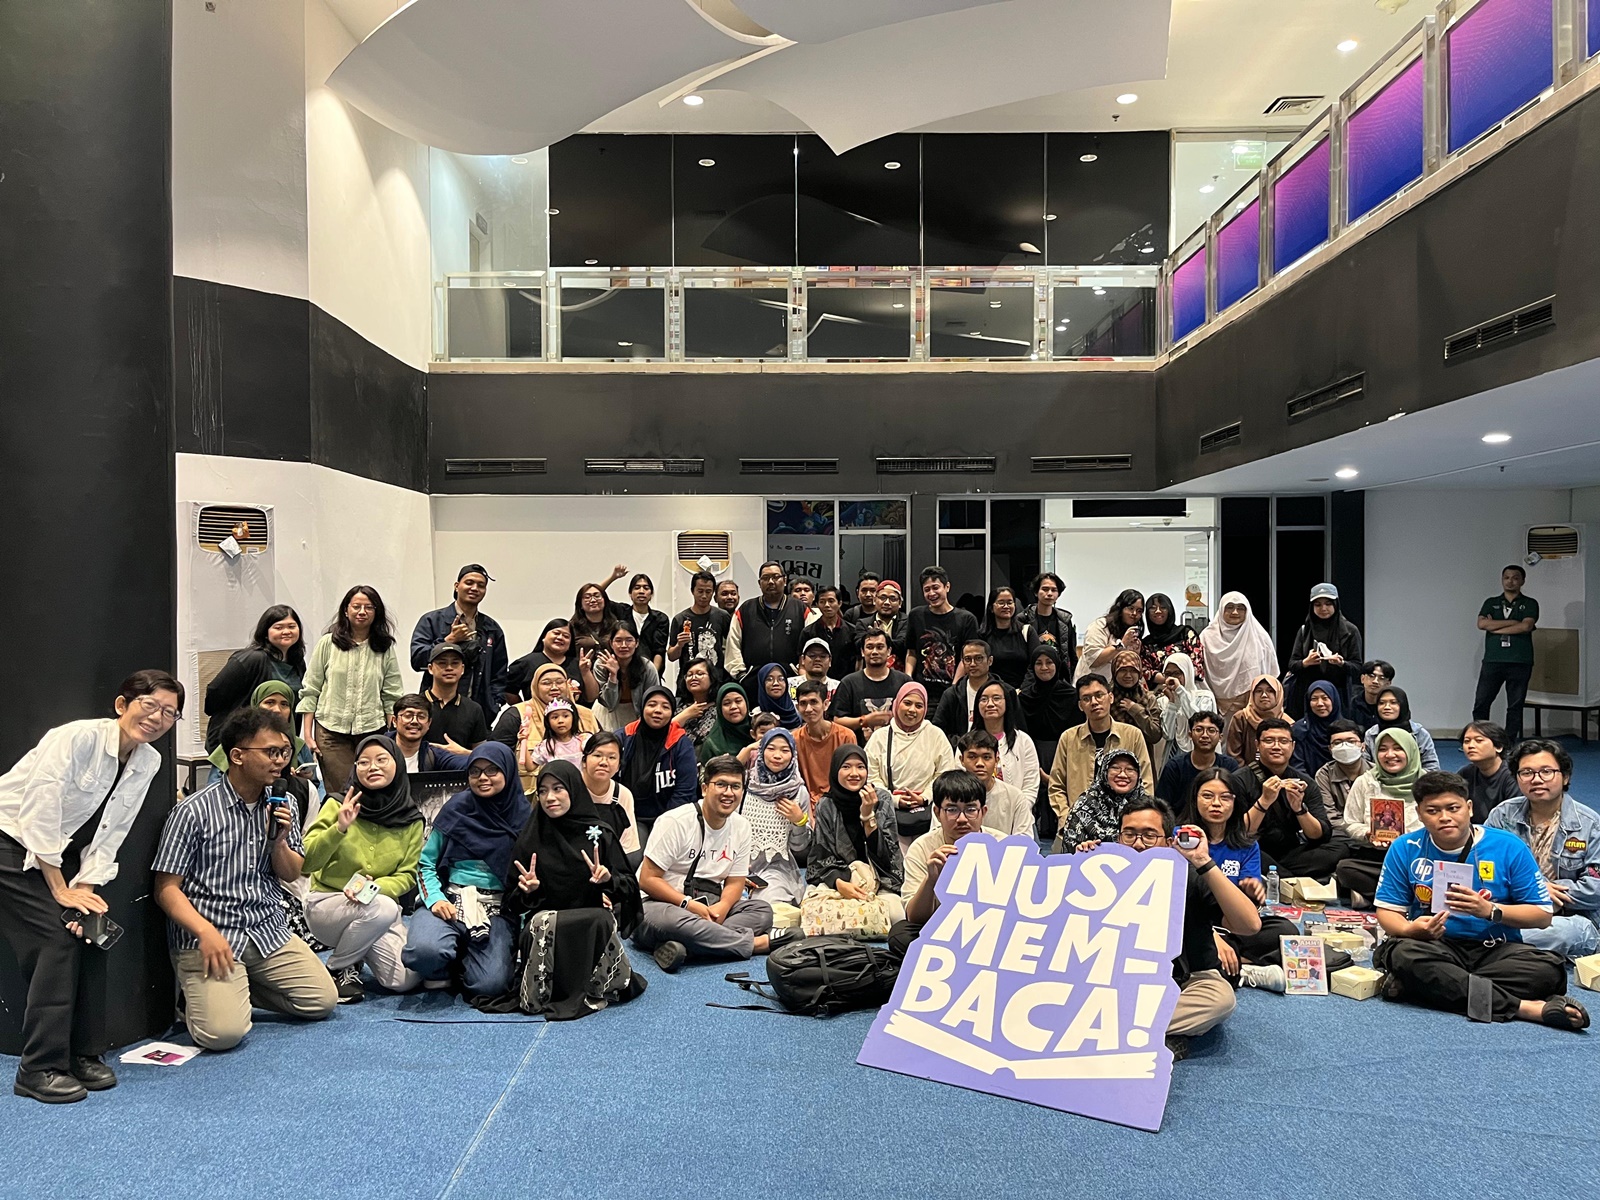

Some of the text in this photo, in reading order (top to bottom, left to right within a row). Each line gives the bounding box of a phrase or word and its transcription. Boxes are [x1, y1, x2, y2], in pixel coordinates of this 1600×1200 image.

[655, 769, 676, 793] TLES
[946, 843, 1174, 953] NUSA
[1414, 858, 1433, 882] hp
[930, 902, 1158, 986] MEM-
[900, 944, 1166, 1053] BACA!
